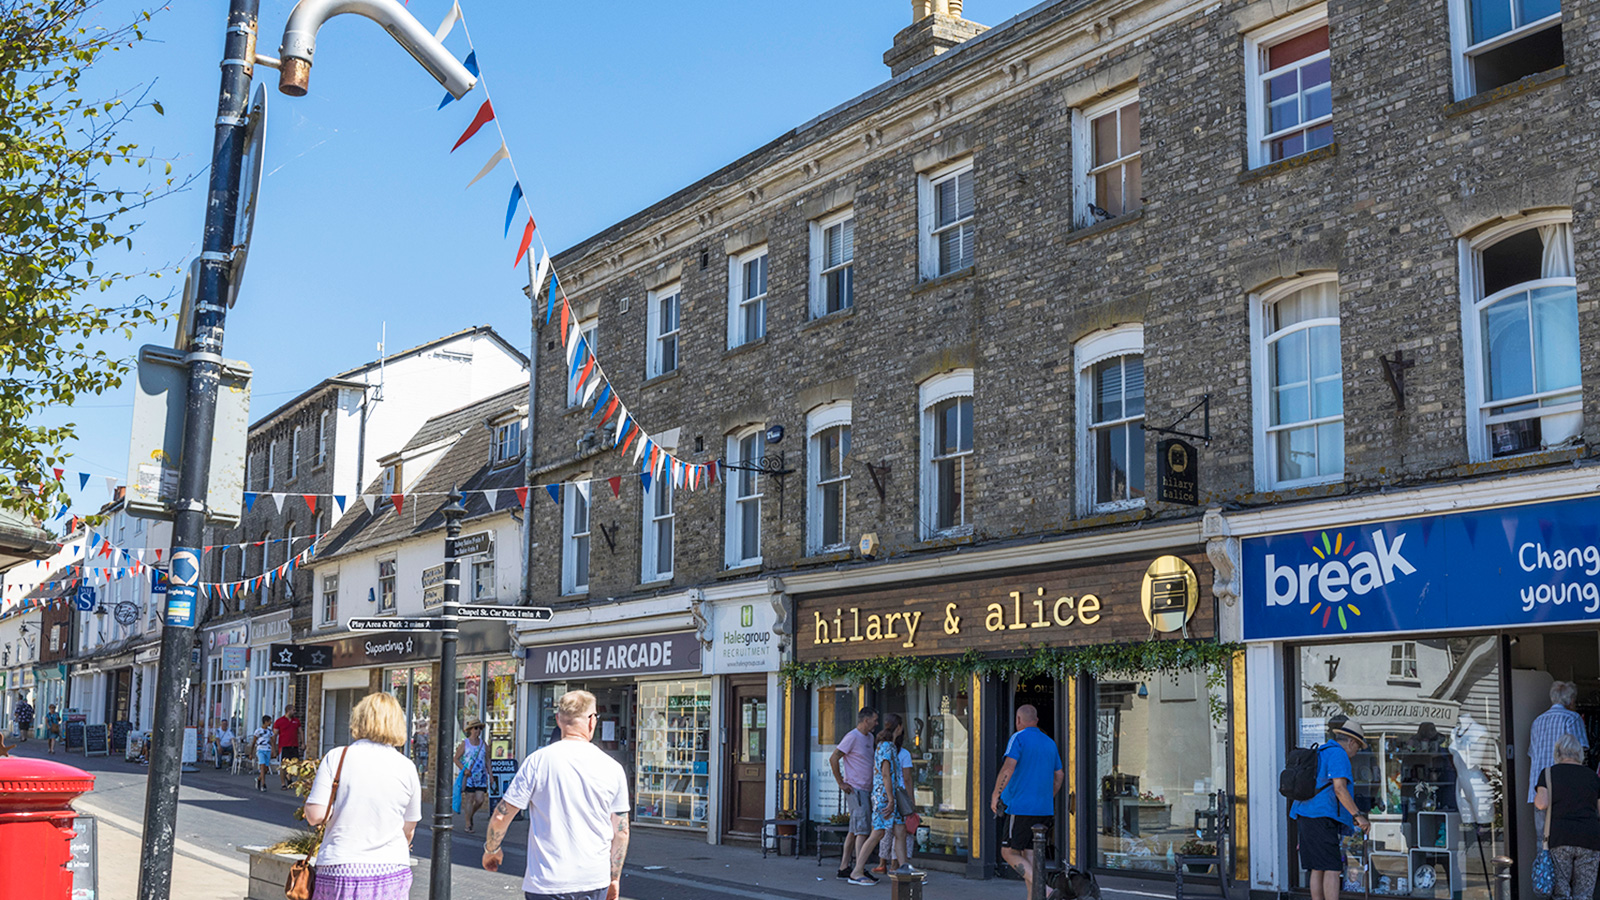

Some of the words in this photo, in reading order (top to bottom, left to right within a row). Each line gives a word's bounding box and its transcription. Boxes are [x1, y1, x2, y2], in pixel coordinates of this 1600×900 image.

[1162, 476, 1194, 491] hilary
[1518, 542, 1600, 576] Chang
[1265, 529, 1417, 606] break
[1520, 582, 1600, 613] young
[457, 608, 479, 616] Chapel
[502, 609, 516, 617] Park
[814, 607, 922, 648] hilary
[943, 602, 961, 636] &
[985, 587, 1101, 632] alice
[351, 621, 365, 629] Play
[723, 630, 771, 646] Halesgroup
[365, 640, 404, 656] Superdrug
[723, 646, 770, 658] RECRUITMENT
[545, 647, 601, 674] MOBILE
[605, 641, 672, 670] ARCADE
